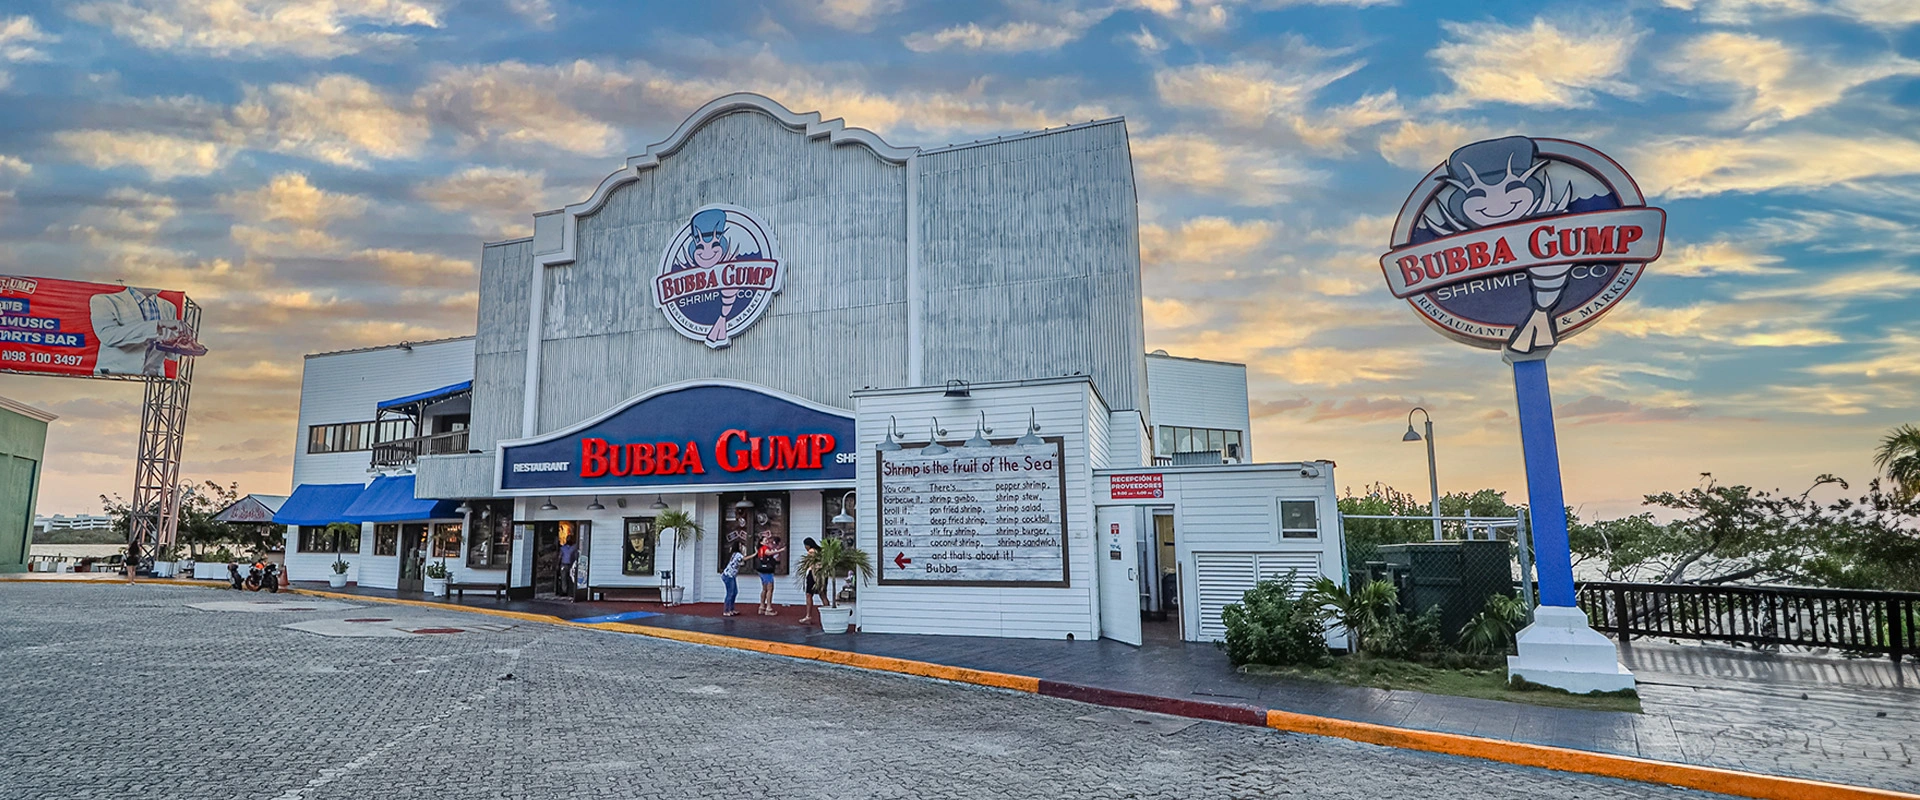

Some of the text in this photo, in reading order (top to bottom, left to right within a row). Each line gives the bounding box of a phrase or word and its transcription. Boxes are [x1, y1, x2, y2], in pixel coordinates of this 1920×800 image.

[1397, 224, 1644, 287] BUBBA GUMP
[662, 264, 774, 300] BUBBA GUMP
[1437, 264, 1609, 301] SHRIMP CO
[680, 289, 754, 307] SHRIMP CO
[1418, 296, 1507, 337] RESTAURANT
[1578, 268, 1636, 318] MARKET
[669, 302, 709, 333] RESTAURANT
[736, 292, 762, 322] MARKET
[8, 316, 55, 330] MUSIC
[44, 333, 78, 346] BAR
[30, 352, 51, 363] 100
[54, 354, 83, 366] 3497
[580, 428, 836, 478] BUBBA GUMP
[513, 461, 570, 473] RESTAURANT
[923, 462, 930, 474] is
[933, 461, 949, 474] the
[953, 458, 978, 473] fruit
[982, 457, 995, 472] of
[999, 456, 1019, 472] the
[884, 485, 896, 493] You
[996, 483, 1020, 492] pepper
[930, 495, 951, 504] shrimp
[996, 493, 1019, 503] shrimp
[943, 505, 959, 513] fried
[996, 504, 1019, 514] shrimp
[930, 517, 946, 526] deep
[996, 515, 1019, 526] shrimp
[996, 526, 1019, 537] shrimp
[930, 538, 957, 547] coconut
[998, 538, 1021, 548] shrimp
[932, 551, 947, 560] and
[975, 551, 999, 560] about
[1003, 550, 1014, 561] it!
[926, 563, 958, 573] Bubba
